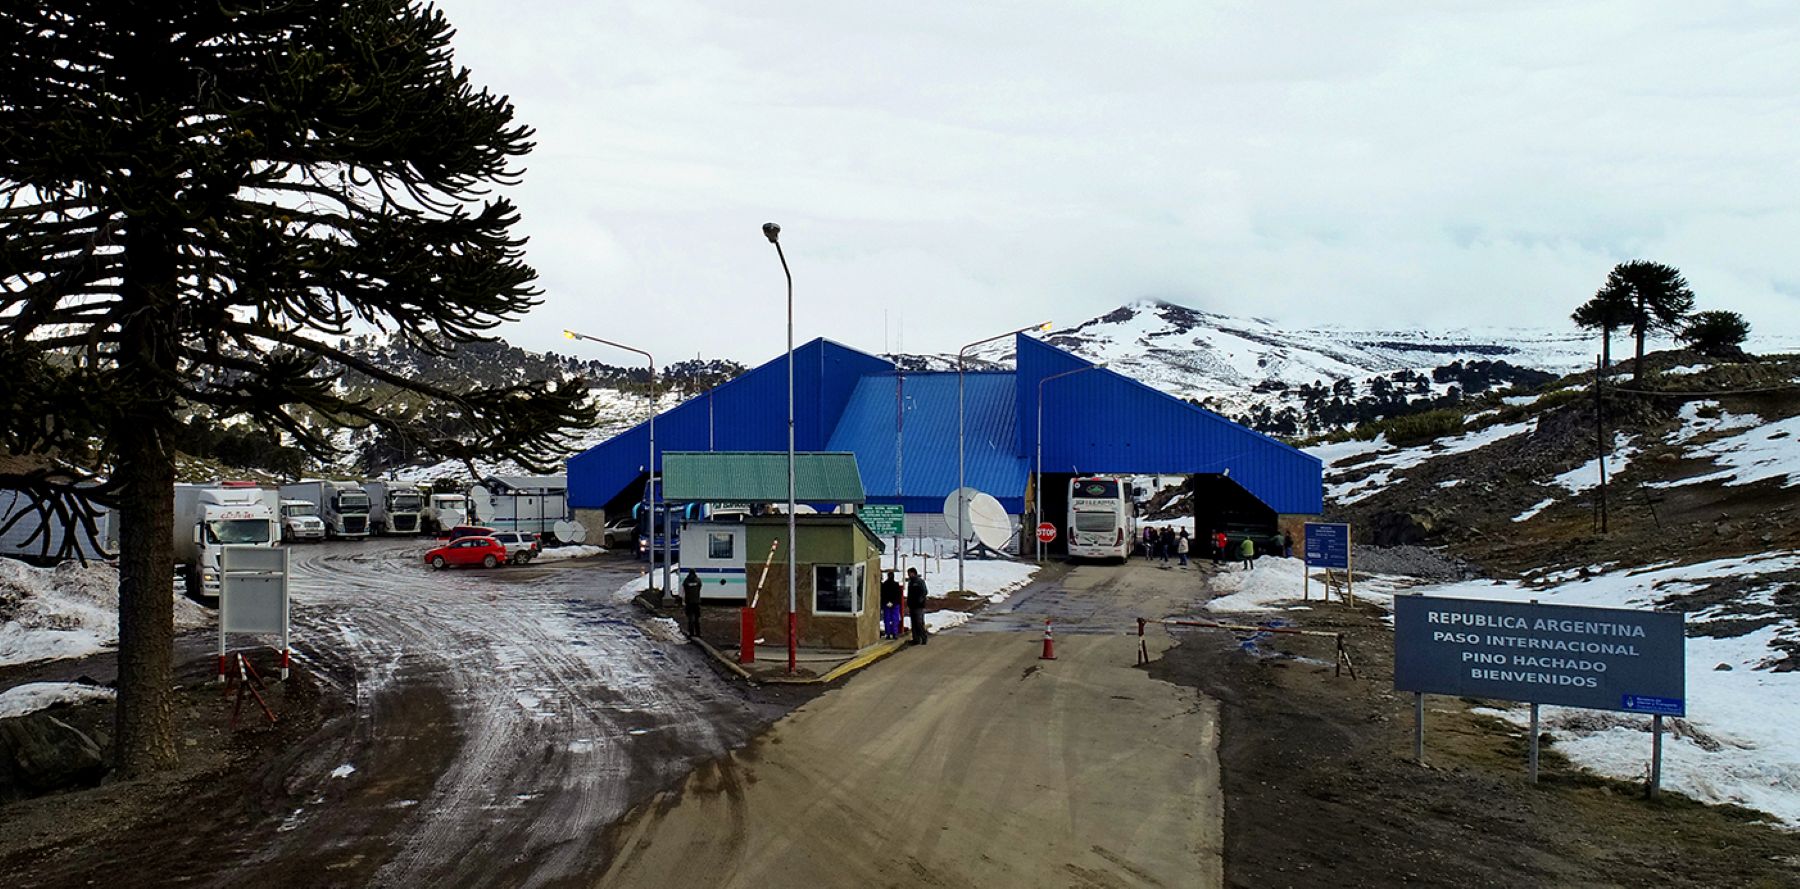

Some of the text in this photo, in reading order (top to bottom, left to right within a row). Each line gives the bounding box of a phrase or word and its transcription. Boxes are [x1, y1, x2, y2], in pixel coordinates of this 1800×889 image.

[1036, 528, 1056, 537] STOP
[1428, 611, 1646, 638] REPUBLICA ARGENTINA
[1433, 631, 1640, 656] PASO INTERNACIONAL
[1462, 652, 1607, 673] PINO HACHADO
[1471, 668, 1598, 688] BIENVENIDOS
